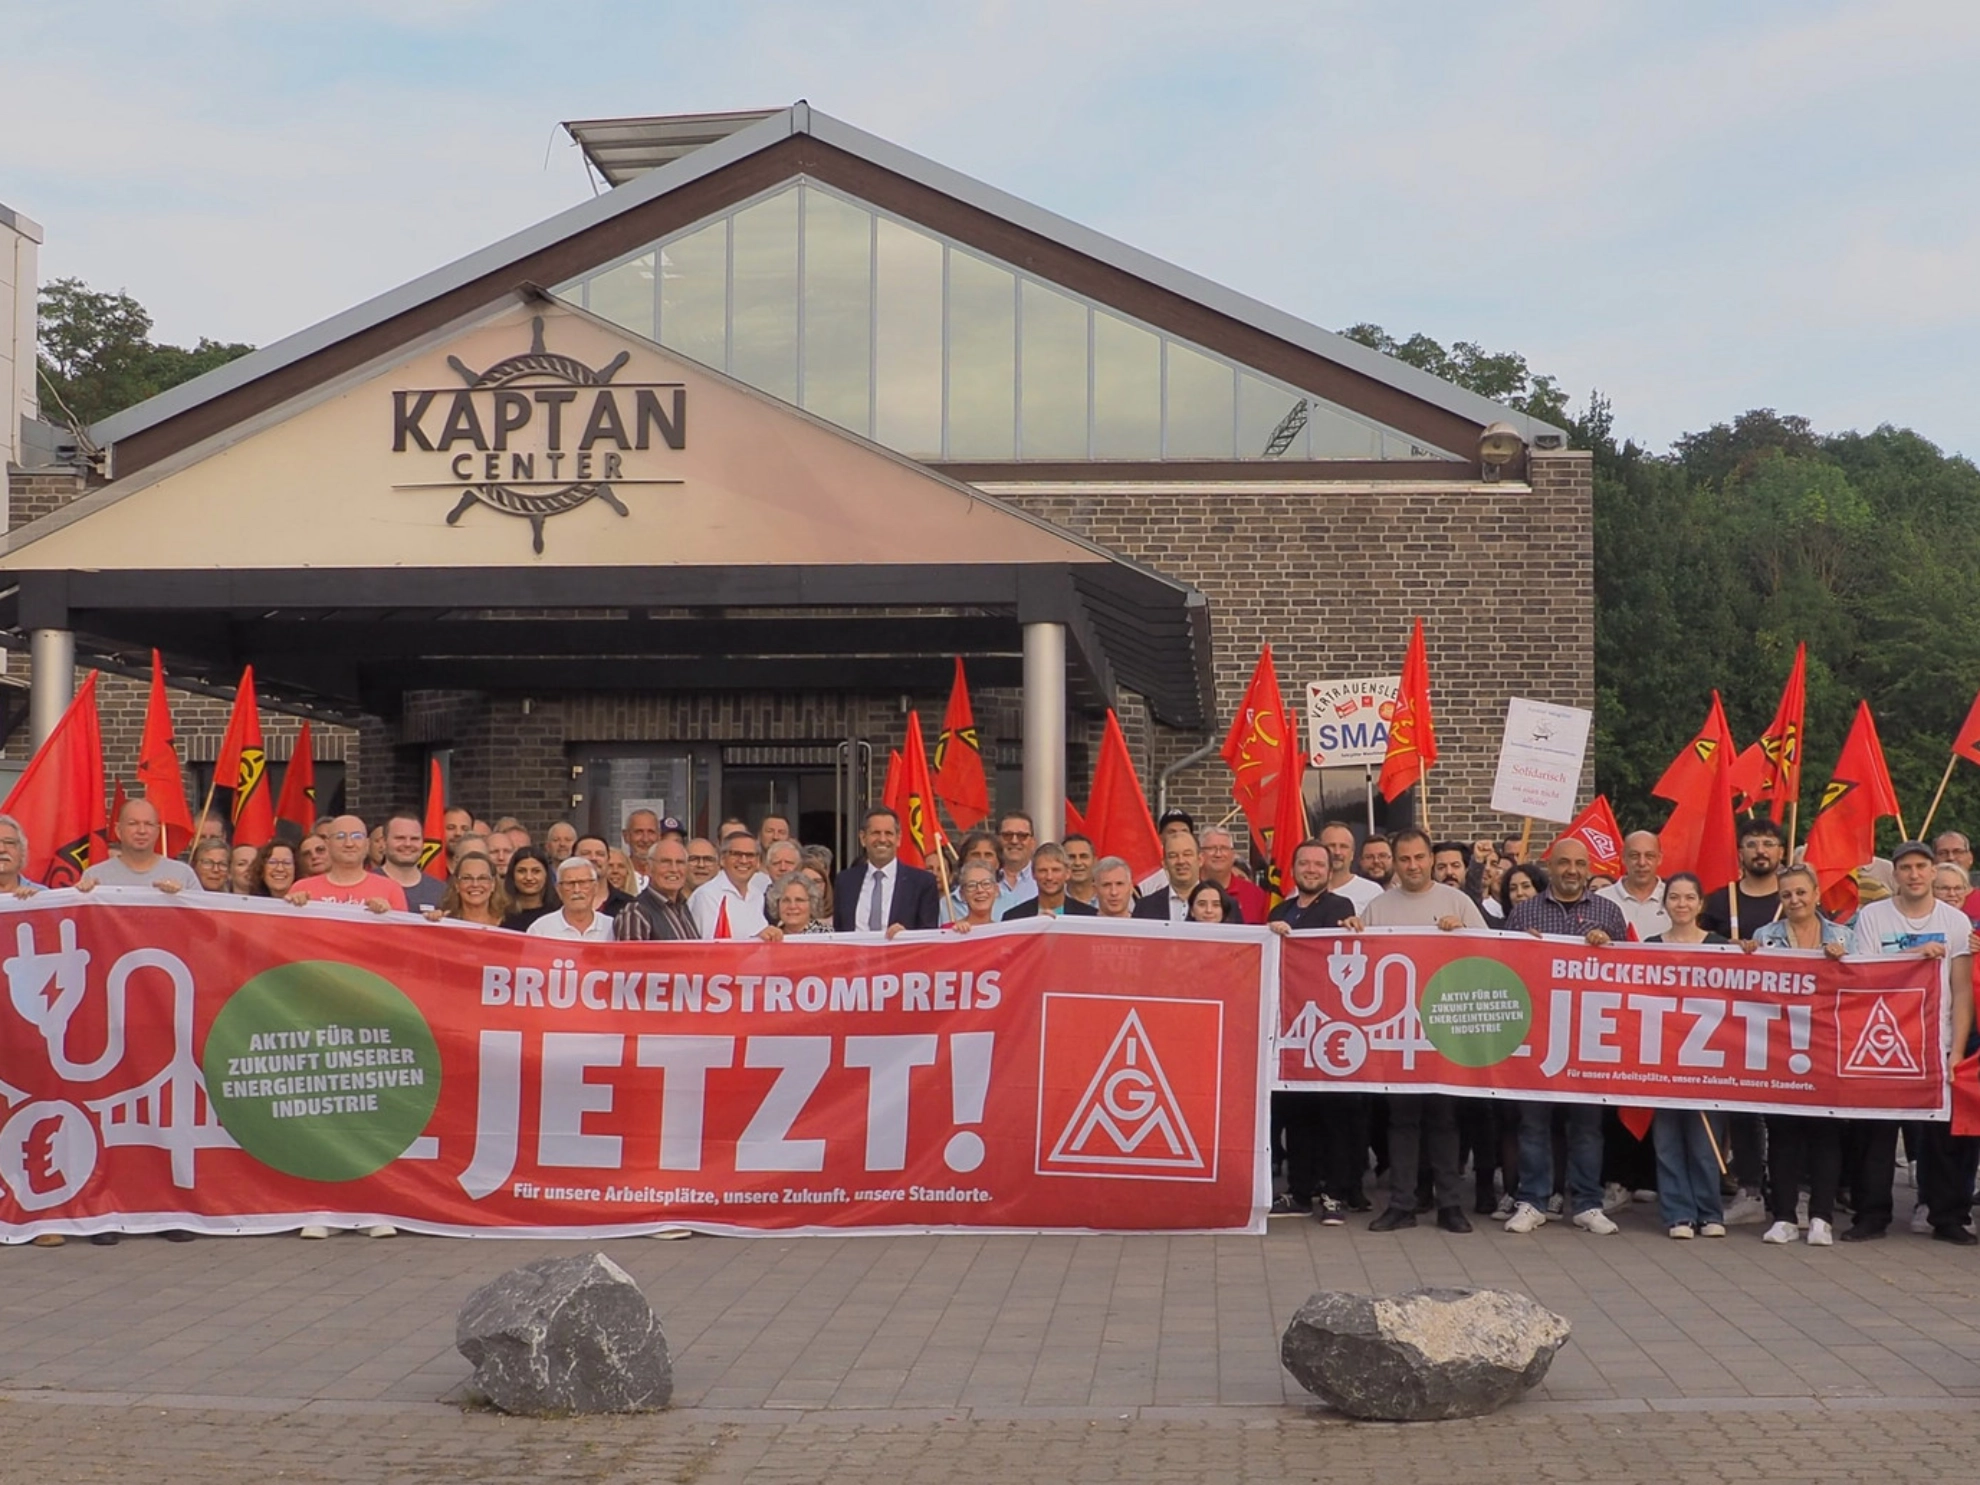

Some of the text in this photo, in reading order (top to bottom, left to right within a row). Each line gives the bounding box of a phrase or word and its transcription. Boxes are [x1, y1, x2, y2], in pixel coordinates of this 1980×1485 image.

[392, 390, 686, 452] KAPTAN
[452, 453, 623, 480] CENTER
[481, 959, 1002, 1013] BRÜCKENSTROMPREIS
[1551, 956, 1817, 995] BRÜCKENSTROMPREIS
[1432, 1001, 1519, 1013] ZUKUNFT UNSERER
[1442, 988, 1509, 1001] AKTIV FÜR DIE
[1428, 1011, 1524, 1024] ENERGIEINTENSIVEN
[1452, 1024, 1502, 1034] INDUSTRIE
[250, 1025, 392, 1051] AKTIV FÜR DIE
[1539, 989, 1812, 1078] JETZT!
[228, 1048, 415, 1076] ZUKUNFT UNSERER
[222, 1068, 424, 1098] ENERGIEINTENSIVEN
[1567, 1068, 1815, 1091] Für unsere Arbeitsplätze, unsere Zukunft, unsere Standorte.
[272, 1094, 378, 1118] INDUSTRIE
[457, 1030, 995, 1200] JETZT!
[513, 1182, 993, 1206] Für unsere Arbeitsplätze, unsere Zukunft, unsere Standorte.
